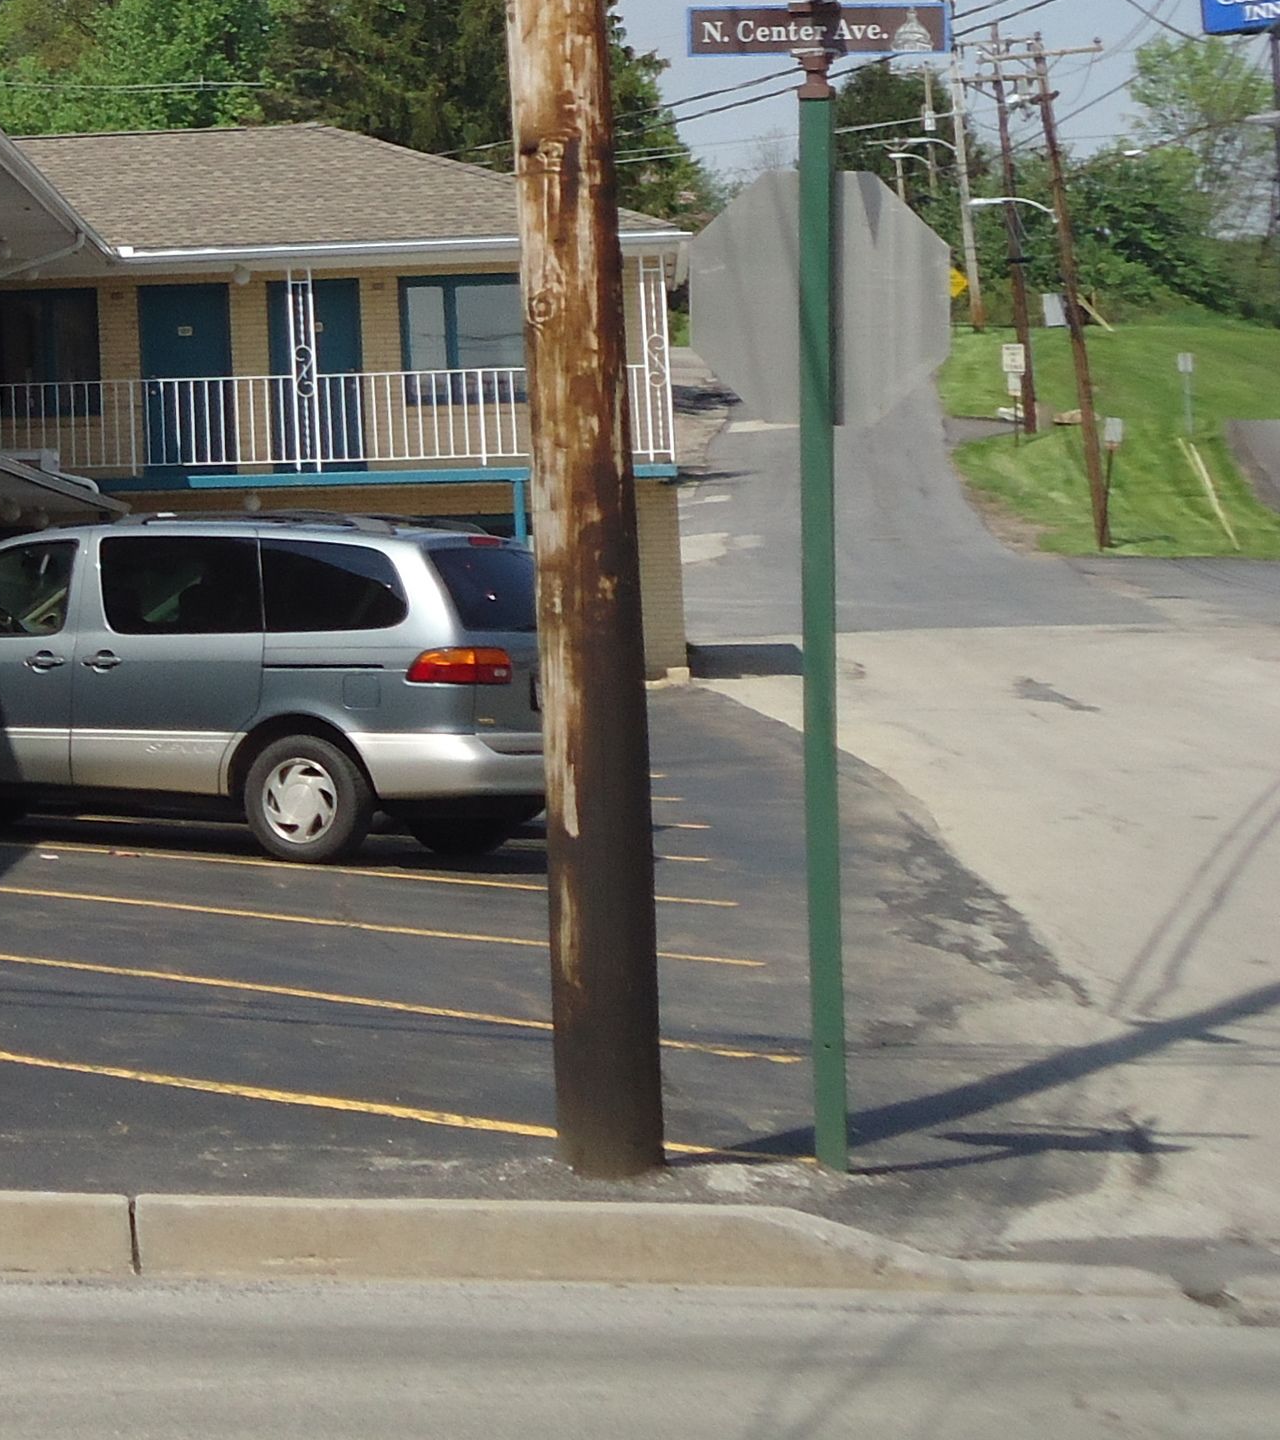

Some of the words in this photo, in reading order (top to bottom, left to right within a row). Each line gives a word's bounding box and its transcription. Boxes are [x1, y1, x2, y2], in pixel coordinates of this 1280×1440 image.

[702, 21, 729, 43] N.
[737, 19, 827, 43] Center
[833, 18, 889, 40] Ave.
